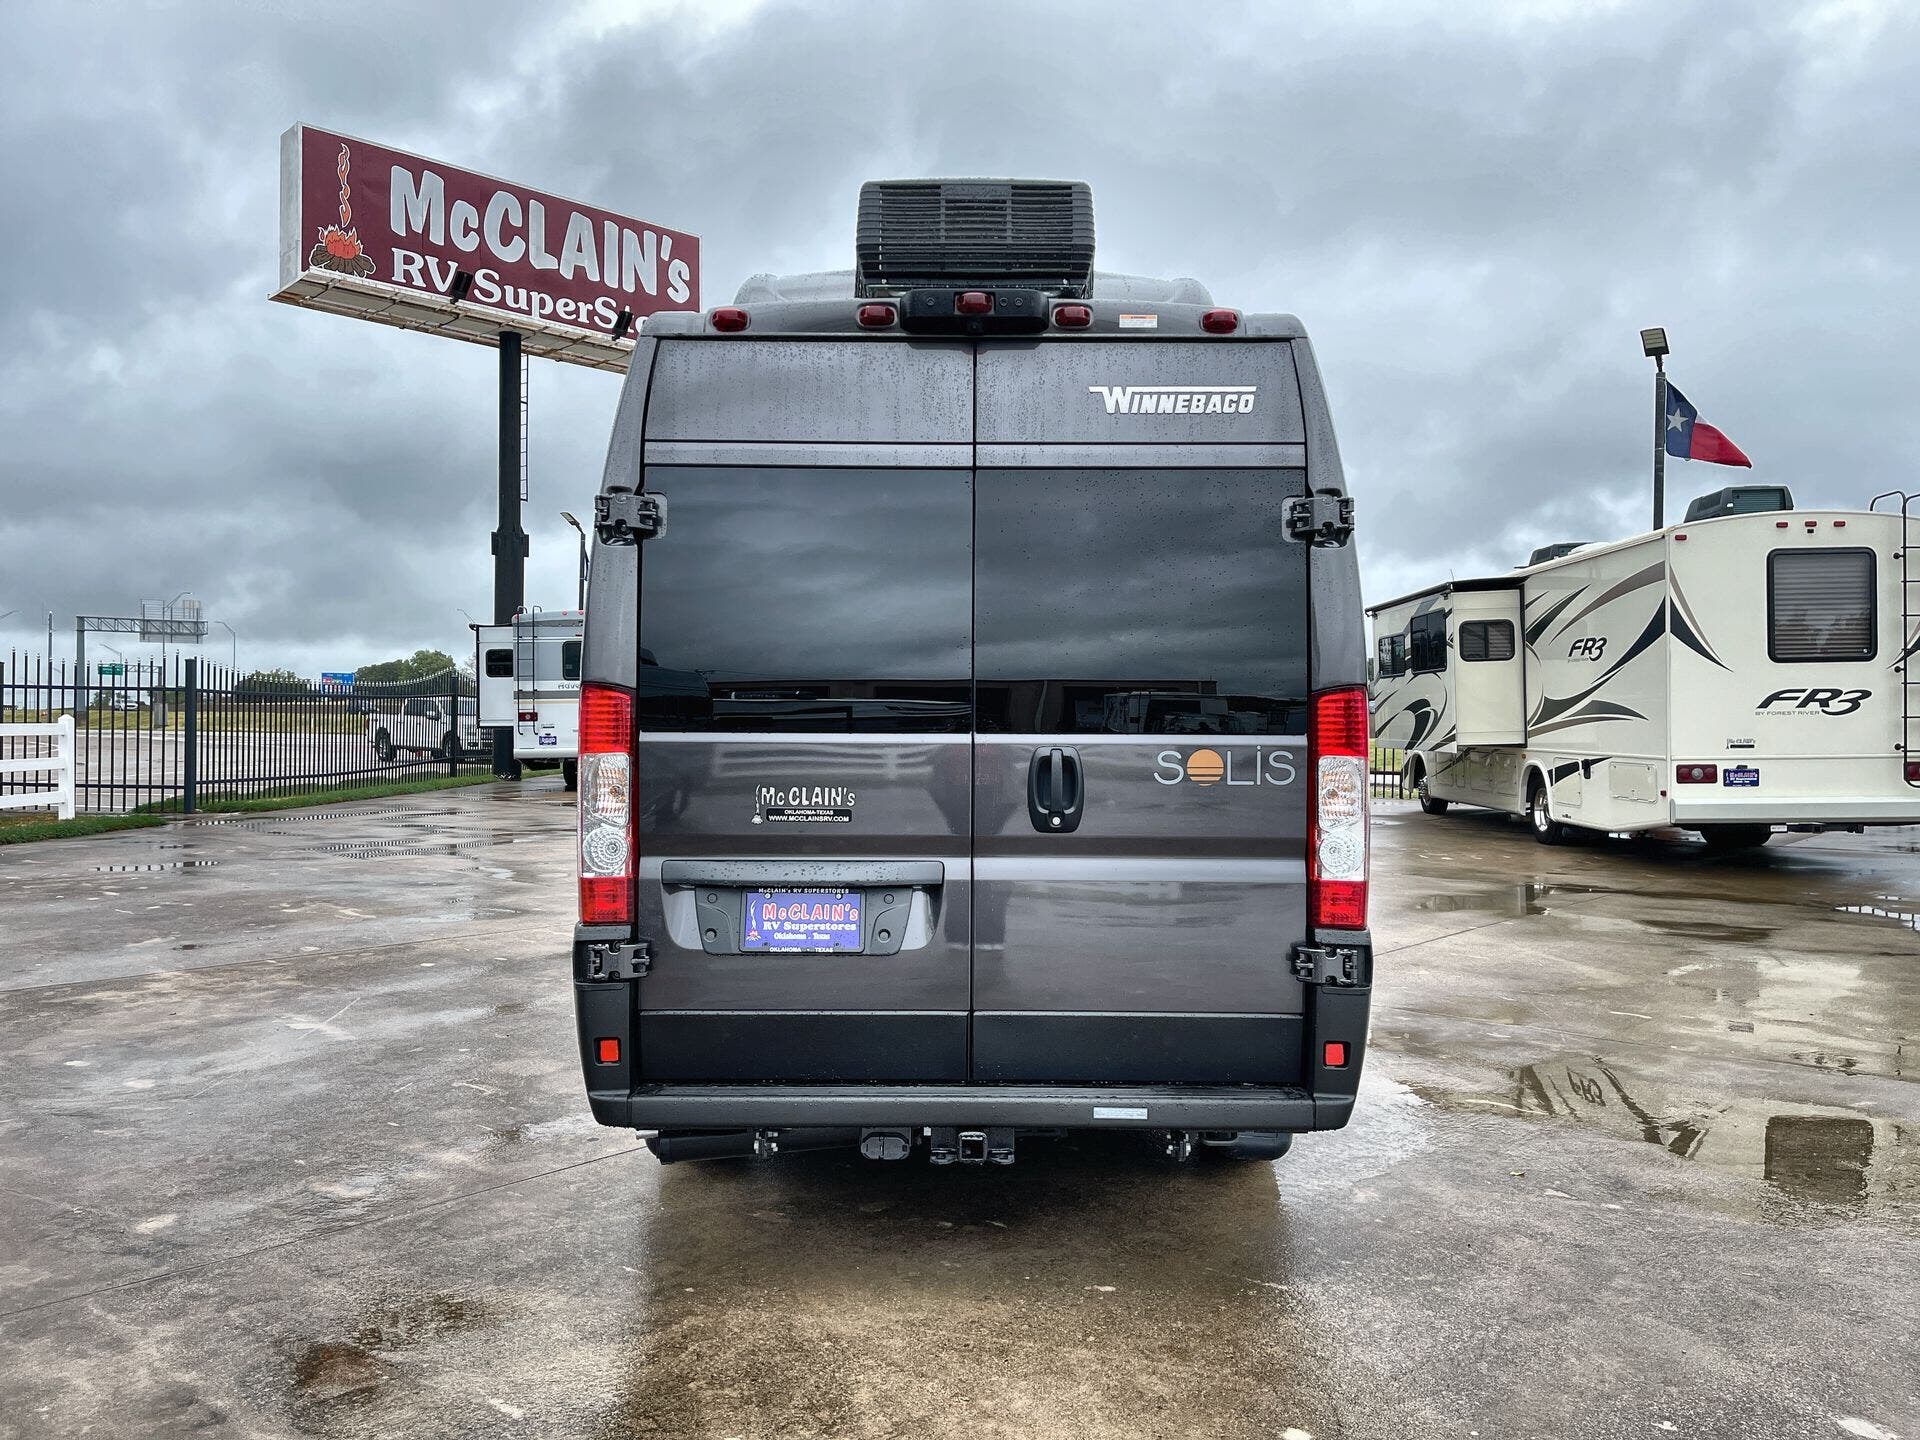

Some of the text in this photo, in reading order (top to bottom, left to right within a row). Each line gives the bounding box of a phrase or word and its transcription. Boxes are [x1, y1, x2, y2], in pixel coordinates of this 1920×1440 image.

[389, 164, 691, 305] McCLAIN's
[391, 247, 650, 335] RV SuperS
[1567, 637, 1608, 662] FR3
[1756, 688, 1873, 716] FR3
[763, 903, 859, 921] McCLAIN's
[763, 921, 856, 931] RV Superstores
